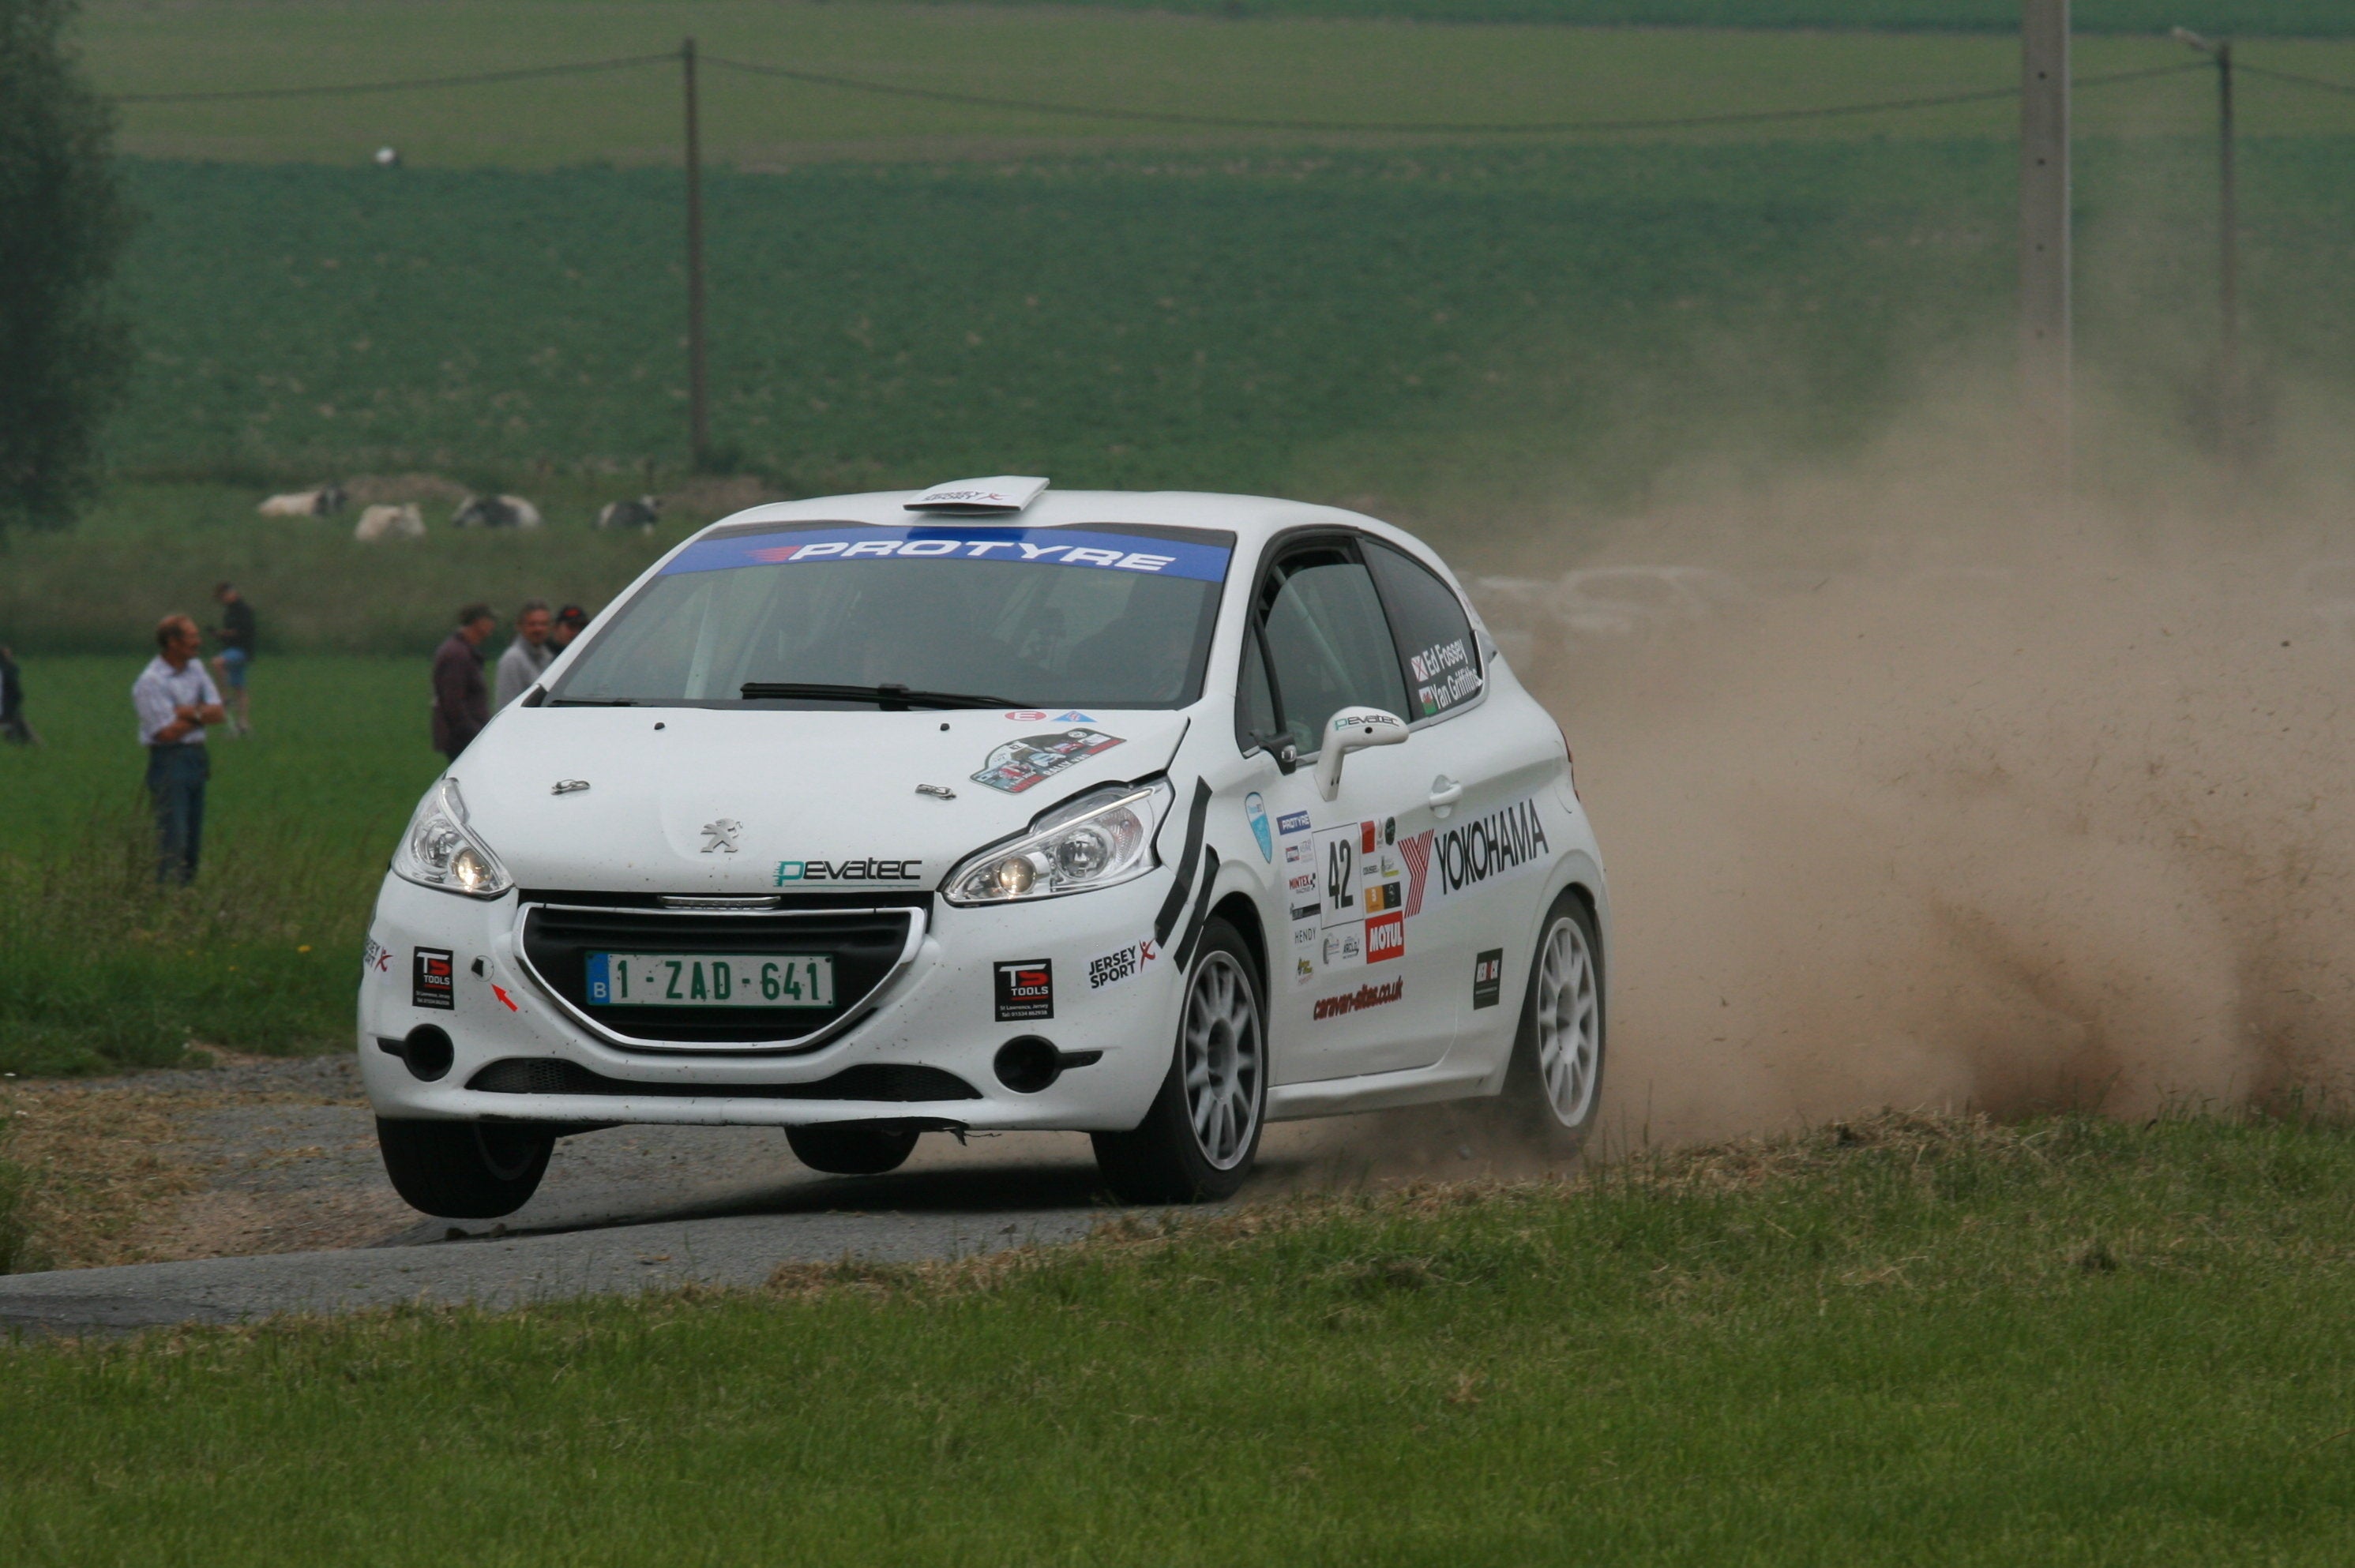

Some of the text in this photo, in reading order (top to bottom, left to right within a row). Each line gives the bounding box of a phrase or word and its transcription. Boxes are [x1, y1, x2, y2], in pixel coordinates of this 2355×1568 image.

[789, 538, 1176, 572] PROTYRE
[1422, 647, 1441, 677] Ed
[1334, 715, 1399, 731] pevatec
[1282, 814, 1309, 831] PROTYRE
[1434, 798, 1549, 895] YOKOHAMA
[772, 857, 922, 887] pevatec
[1289, 874, 1312, 890] MINTEX
[1328, 838, 1354, 910] 42
[1294, 926, 1316, 944] HENDY
[1369, 921, 1403, 952] MOTUL
[416, 951, 451, 976] TS
[1088, 945, 1136, 976] JERSEY
[423, 975, 451, 985] TOOLS
[998, 963, 1050, 987] TS
[1090, 960, 1136, 989] SPORT
[593, 981, 607, 998] B
[1011, 986, 1049, 996] TOOLS
